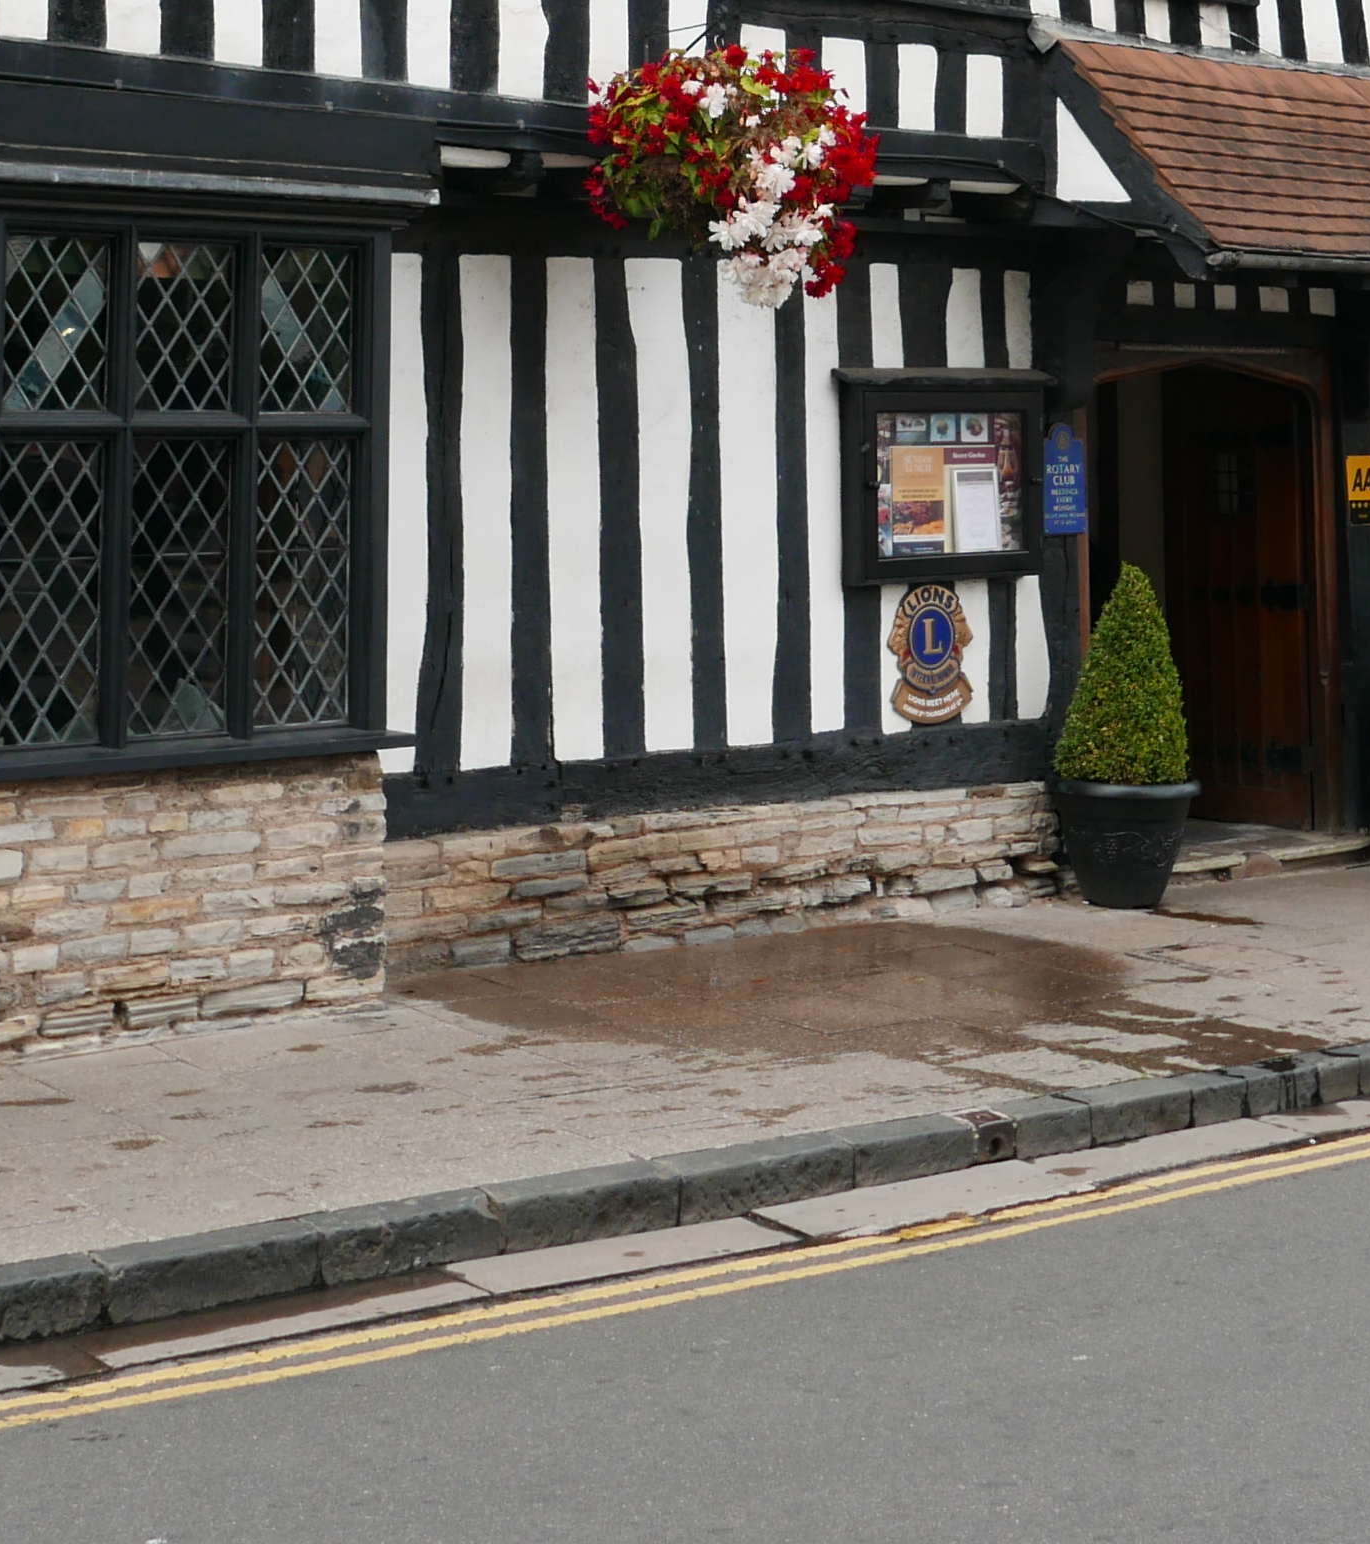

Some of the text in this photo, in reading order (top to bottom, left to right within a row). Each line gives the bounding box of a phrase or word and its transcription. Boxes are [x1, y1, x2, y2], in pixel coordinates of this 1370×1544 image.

[1045, 463, 1081, 474] ROTARY
[1052, 475, 1076, 486] CLUB
[906, 587, 955, 610] LIONS
[922, 618, 943, 654] L
